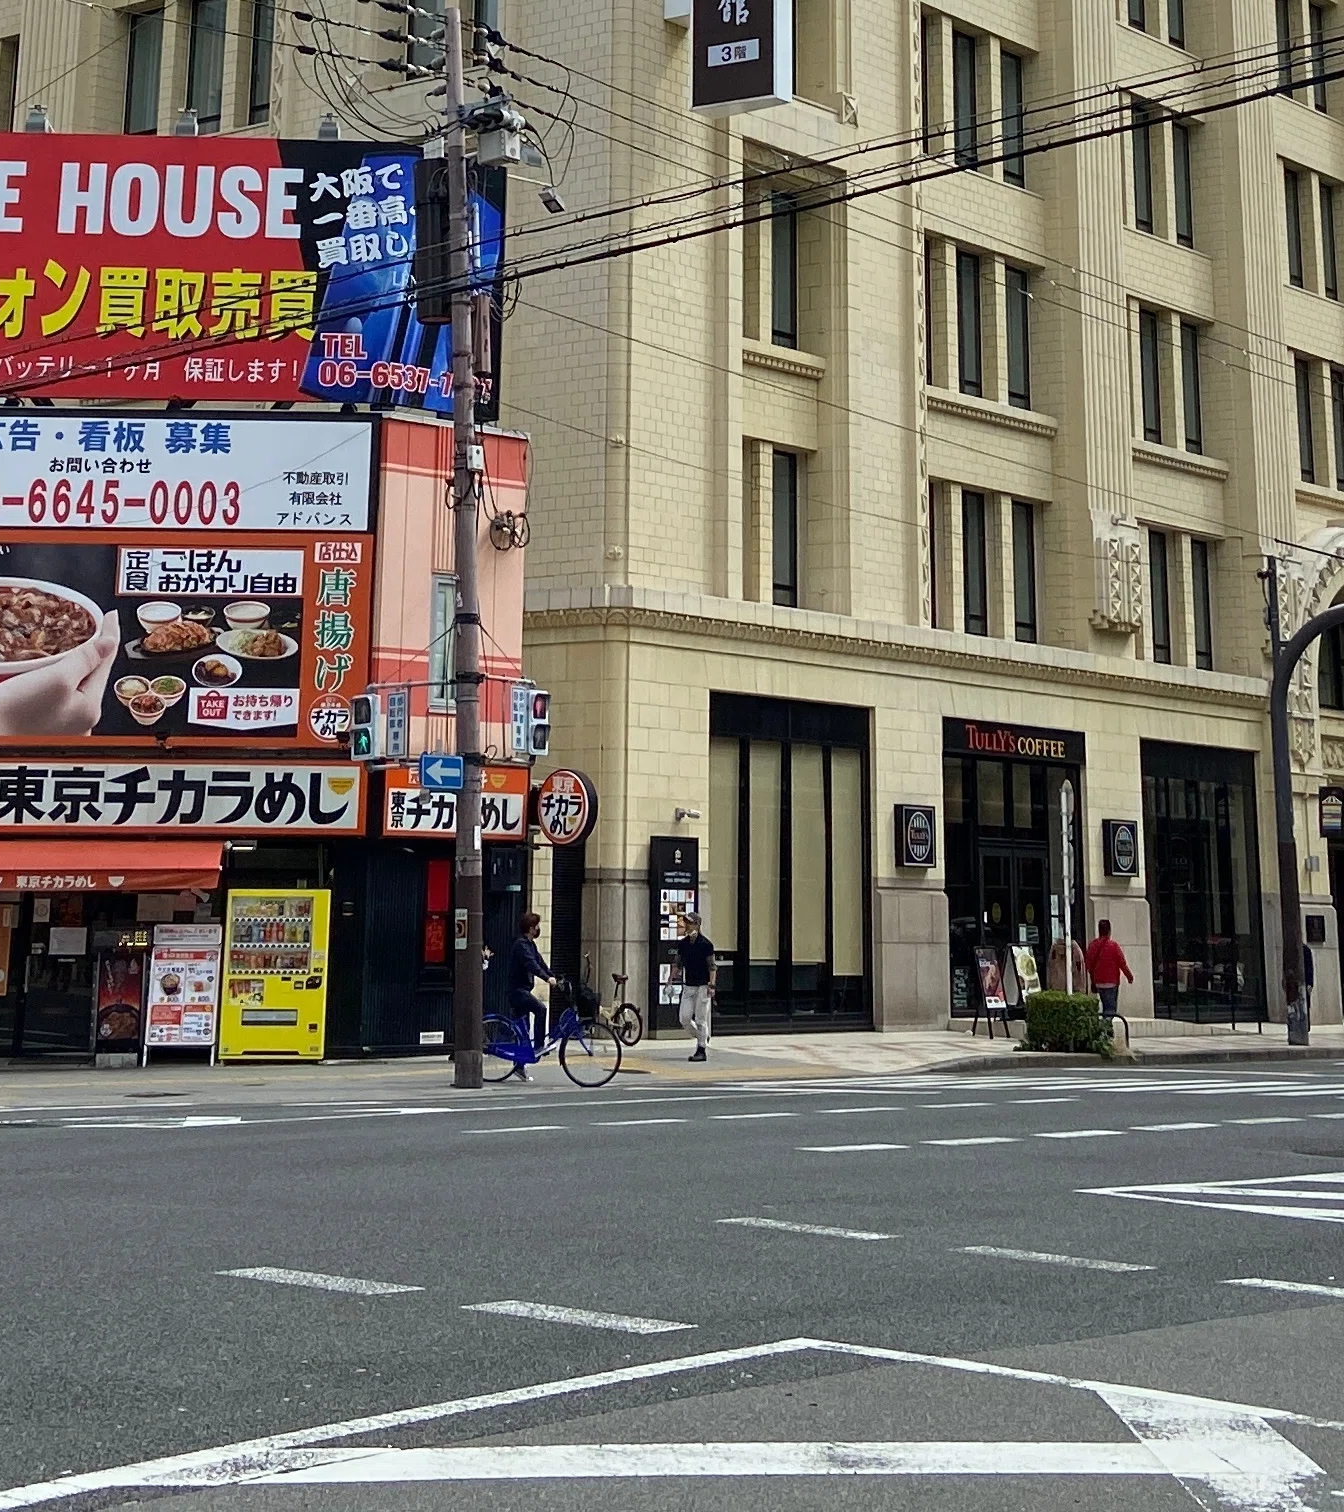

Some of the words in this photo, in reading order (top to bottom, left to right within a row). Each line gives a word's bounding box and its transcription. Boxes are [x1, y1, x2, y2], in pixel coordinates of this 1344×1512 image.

[721, 43, 747, 63] 3階
[309, 163, 404, 202] 大阪で
[57, 161, 304, 240] HOUSE
[312, 195, 417, 231] 一番高
[316, 230, 417, 269] 買取し
[319, 333, 368, 360] TEL
[165, 420, 231, 455] 募集
[48, 456, 153, 475] お問い合わせ
[282, 471, 349, 486] 不動産取引
[289, 491, 343, 506] 有限会社
[276, 511, 353, 526] アドバンス
[160, 549, 242, 573] ごはん
[317, 542, 359, 562] 店仕込
[125, 550, 150, 592] 定食
[157, 573, 298, 594] おかわり自由
[313, 566, 358, 693] 唐揚げ
[200, 699, 225, 708] TAKE
[232, 694, 294, 708] お持ち帰り
[202, 708, 222, 717] OUT
[312, 709, 350, 725] チカラ
[1017, 737, 1066, 759] COFFEE
[390, 791, 406, 828] 東京
[406, 796, 521, 831] チカめし
[541, 793, 583, 816] チカラ
[549, 815, 574, 836] めし
[15, 874, 97, 889] 東京チカラめし
